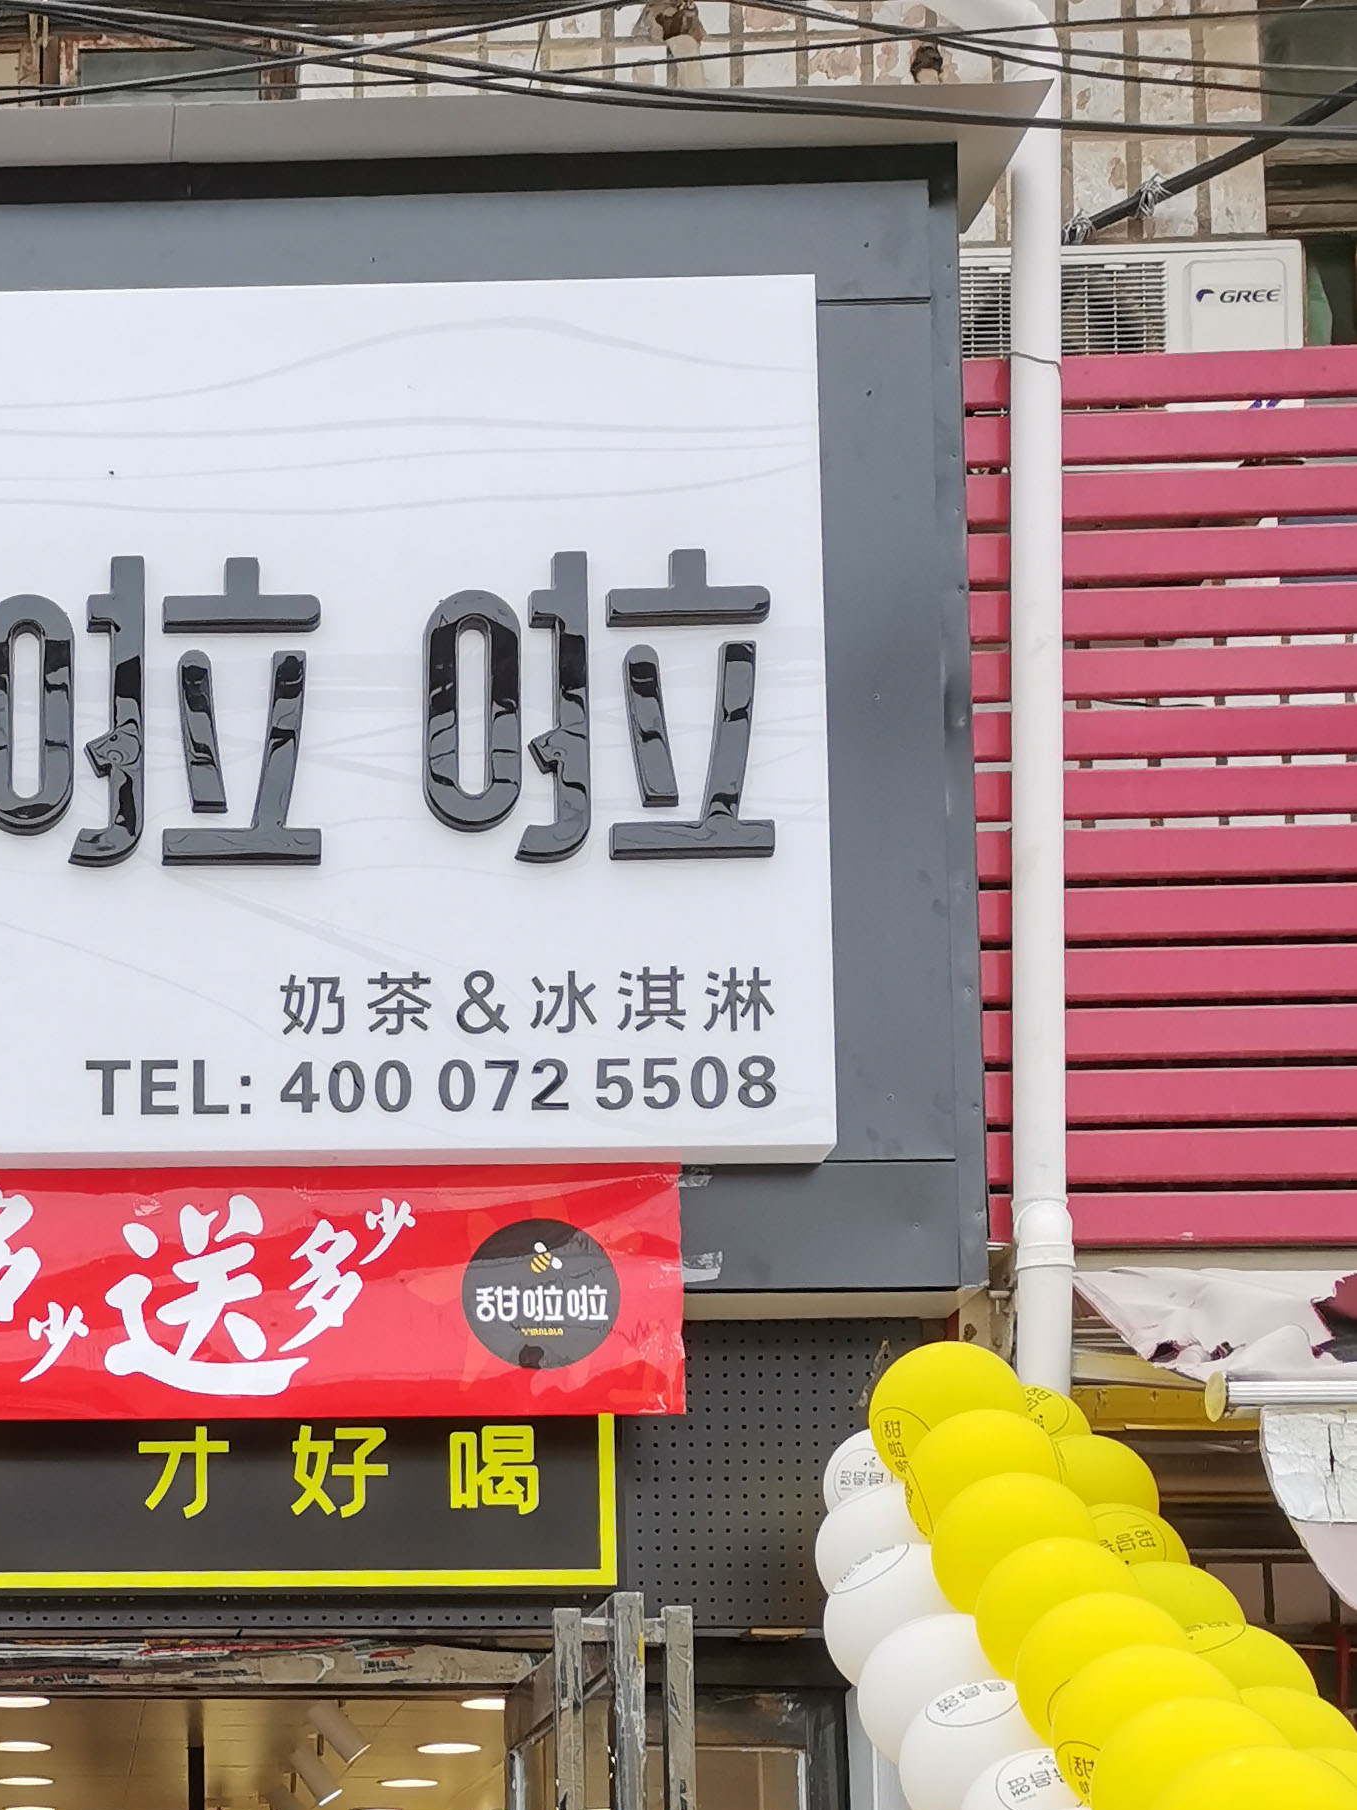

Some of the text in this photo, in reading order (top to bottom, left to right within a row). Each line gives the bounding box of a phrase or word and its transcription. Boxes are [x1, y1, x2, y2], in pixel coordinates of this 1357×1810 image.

[1219, 288, 1282, 305] GREE
[278, 966, 776, 1036] 奶茶&冰淇淋
[85, 1053, 778, 1117] TEL: 400 072 5508
[475, 1284, 609, 1322] 甜啦啦
[137, 1424, 541, 1518] 才好喝
